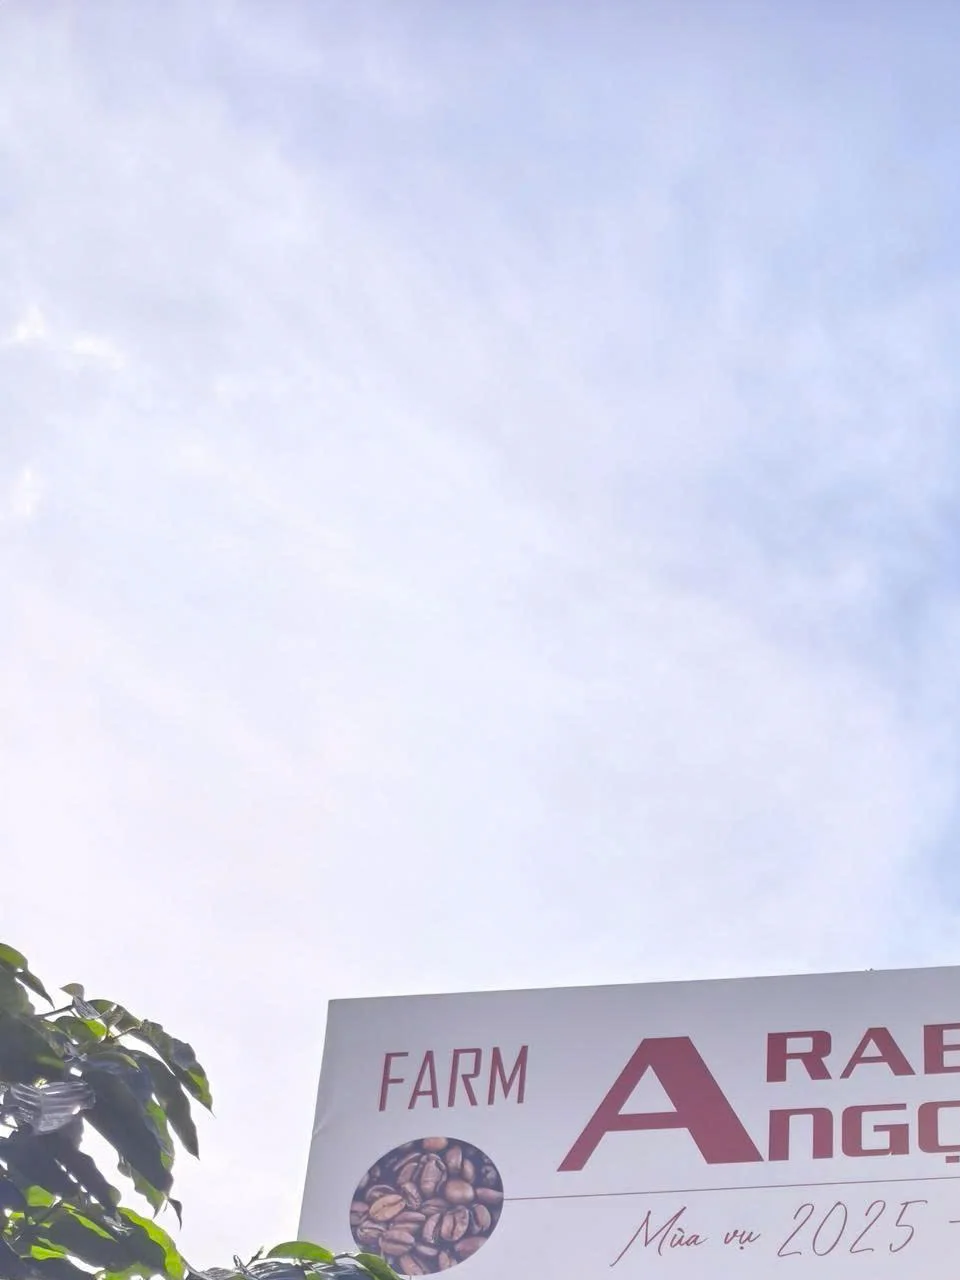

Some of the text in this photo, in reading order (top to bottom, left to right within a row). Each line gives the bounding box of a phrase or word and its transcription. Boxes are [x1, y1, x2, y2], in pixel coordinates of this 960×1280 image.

[378, 1044, 529, 1112] FARM
[609, 1206, 708, 1268] Mùa
[723, 1228, 761, 1251] vụ
[776, 1199, 928, 1258] 2025
